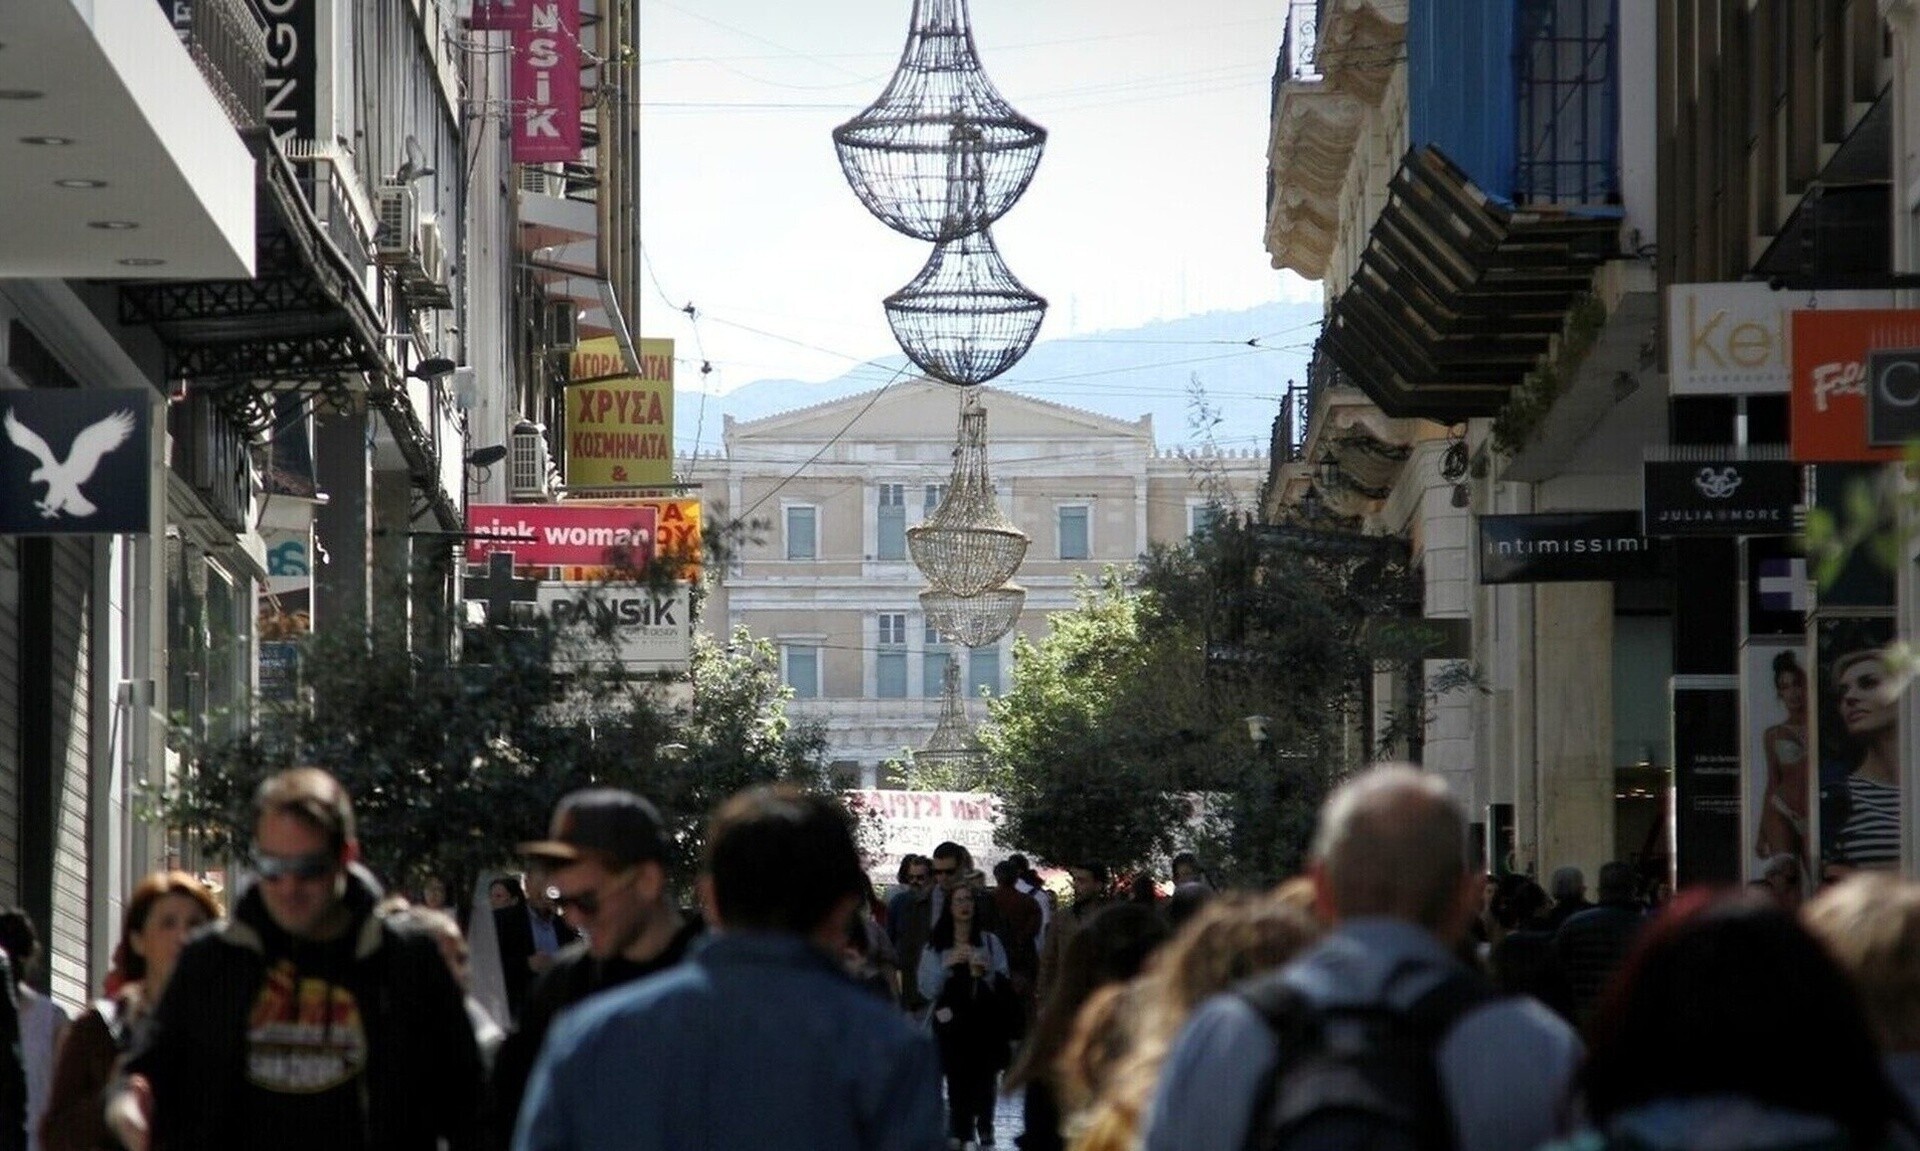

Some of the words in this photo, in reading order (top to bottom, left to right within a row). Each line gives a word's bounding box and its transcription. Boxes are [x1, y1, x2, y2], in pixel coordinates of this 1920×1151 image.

[572, 353, 671, 381] ΑΓΟΡΑΝΤΑΙ
[579, 389, 664, 424] ΧΡΥΣΑ
[573, 432, 668, 460] ΚΟΣΜΗΜΑΤΑ
[1659, 510, 1713, 521] JULIA
[1731, 509, 1780, 520] MORE
[473, 519, 536, 549] pink
[544, 526, 650, 546] woman
[1488, 537, 1648, 554] intimissimi
